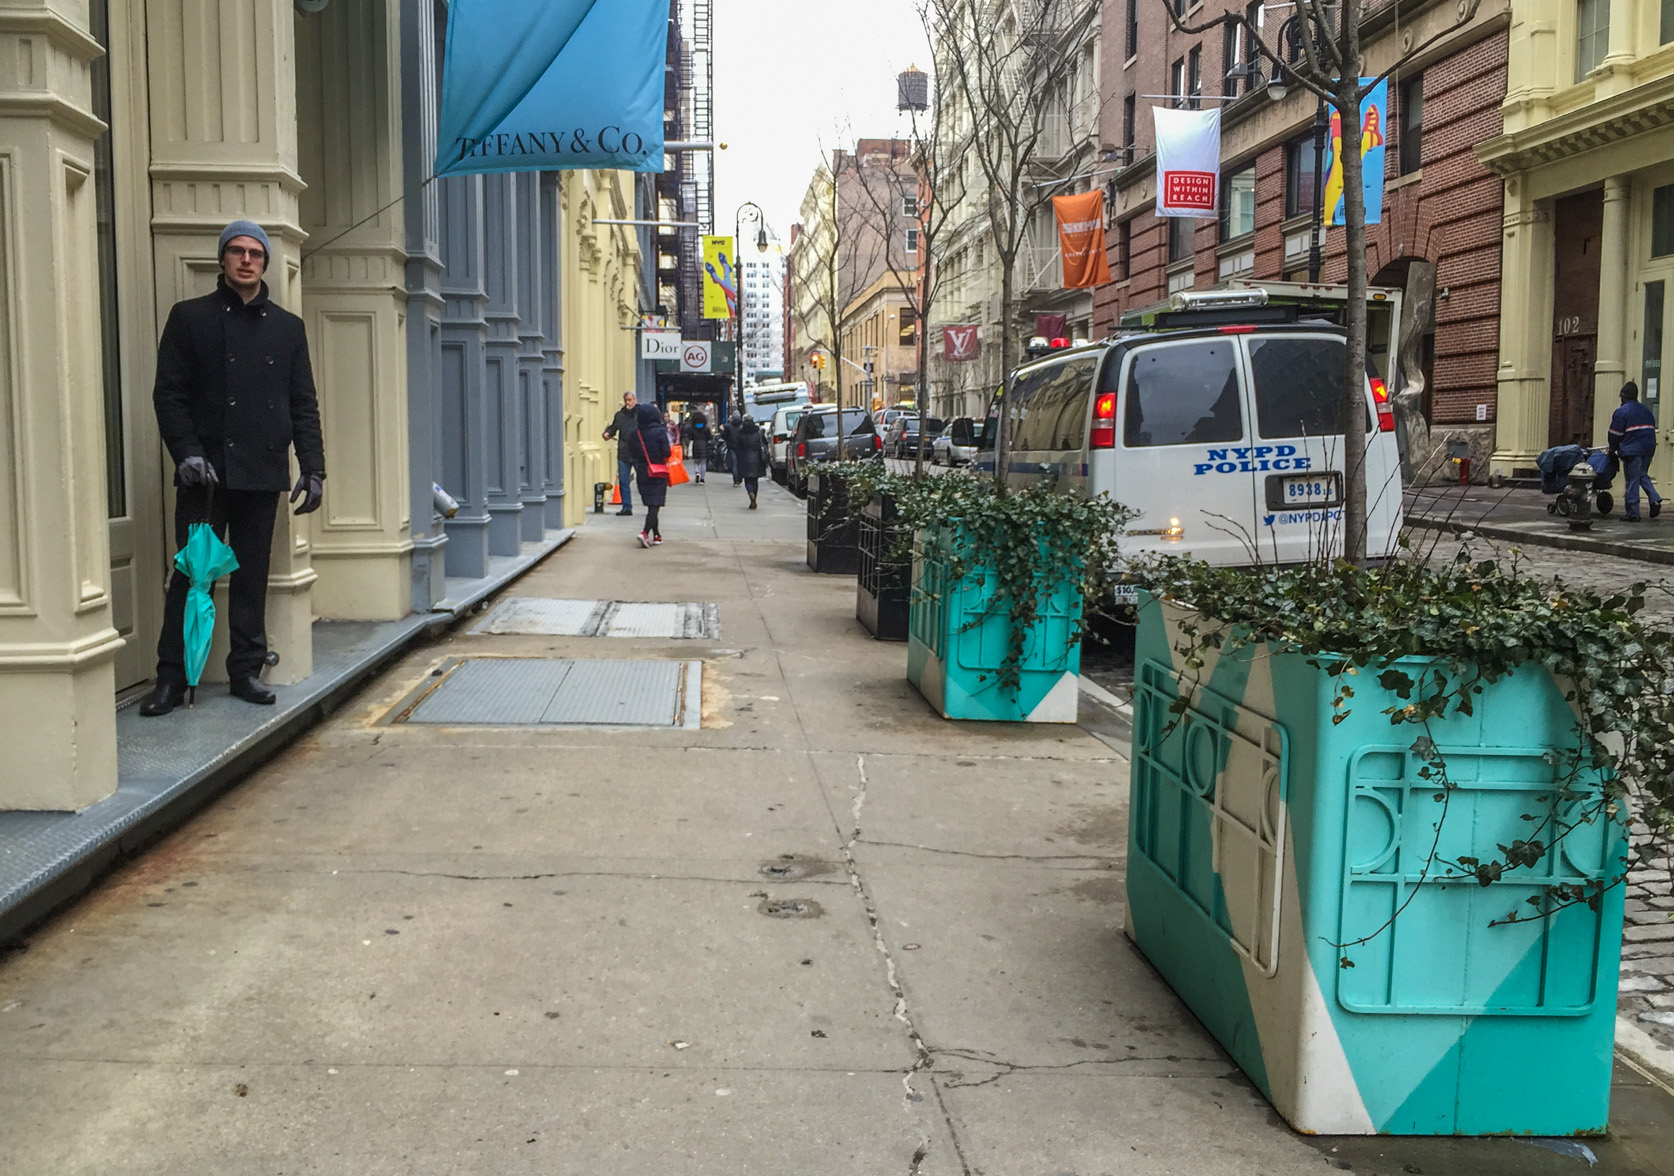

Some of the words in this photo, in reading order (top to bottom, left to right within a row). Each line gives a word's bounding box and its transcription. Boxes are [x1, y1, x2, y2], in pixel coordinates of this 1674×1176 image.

[456, 131, 566, 161] TIFFANY
[570, 127, 592, 154] &
[1173, 177, 1210, 185] DESIGN
[1173, 186, 1209, 194] WITHIN
[1173, 194, 1208, 202] REACH
[1557, 316, 1580, 336] 102
[646, 338, 680, 354] Dior
[687, 352, 704, 362] AG
[1207, 445, 1297, 461] NYPD
[1193, 457, 1312, 476] POLICE
